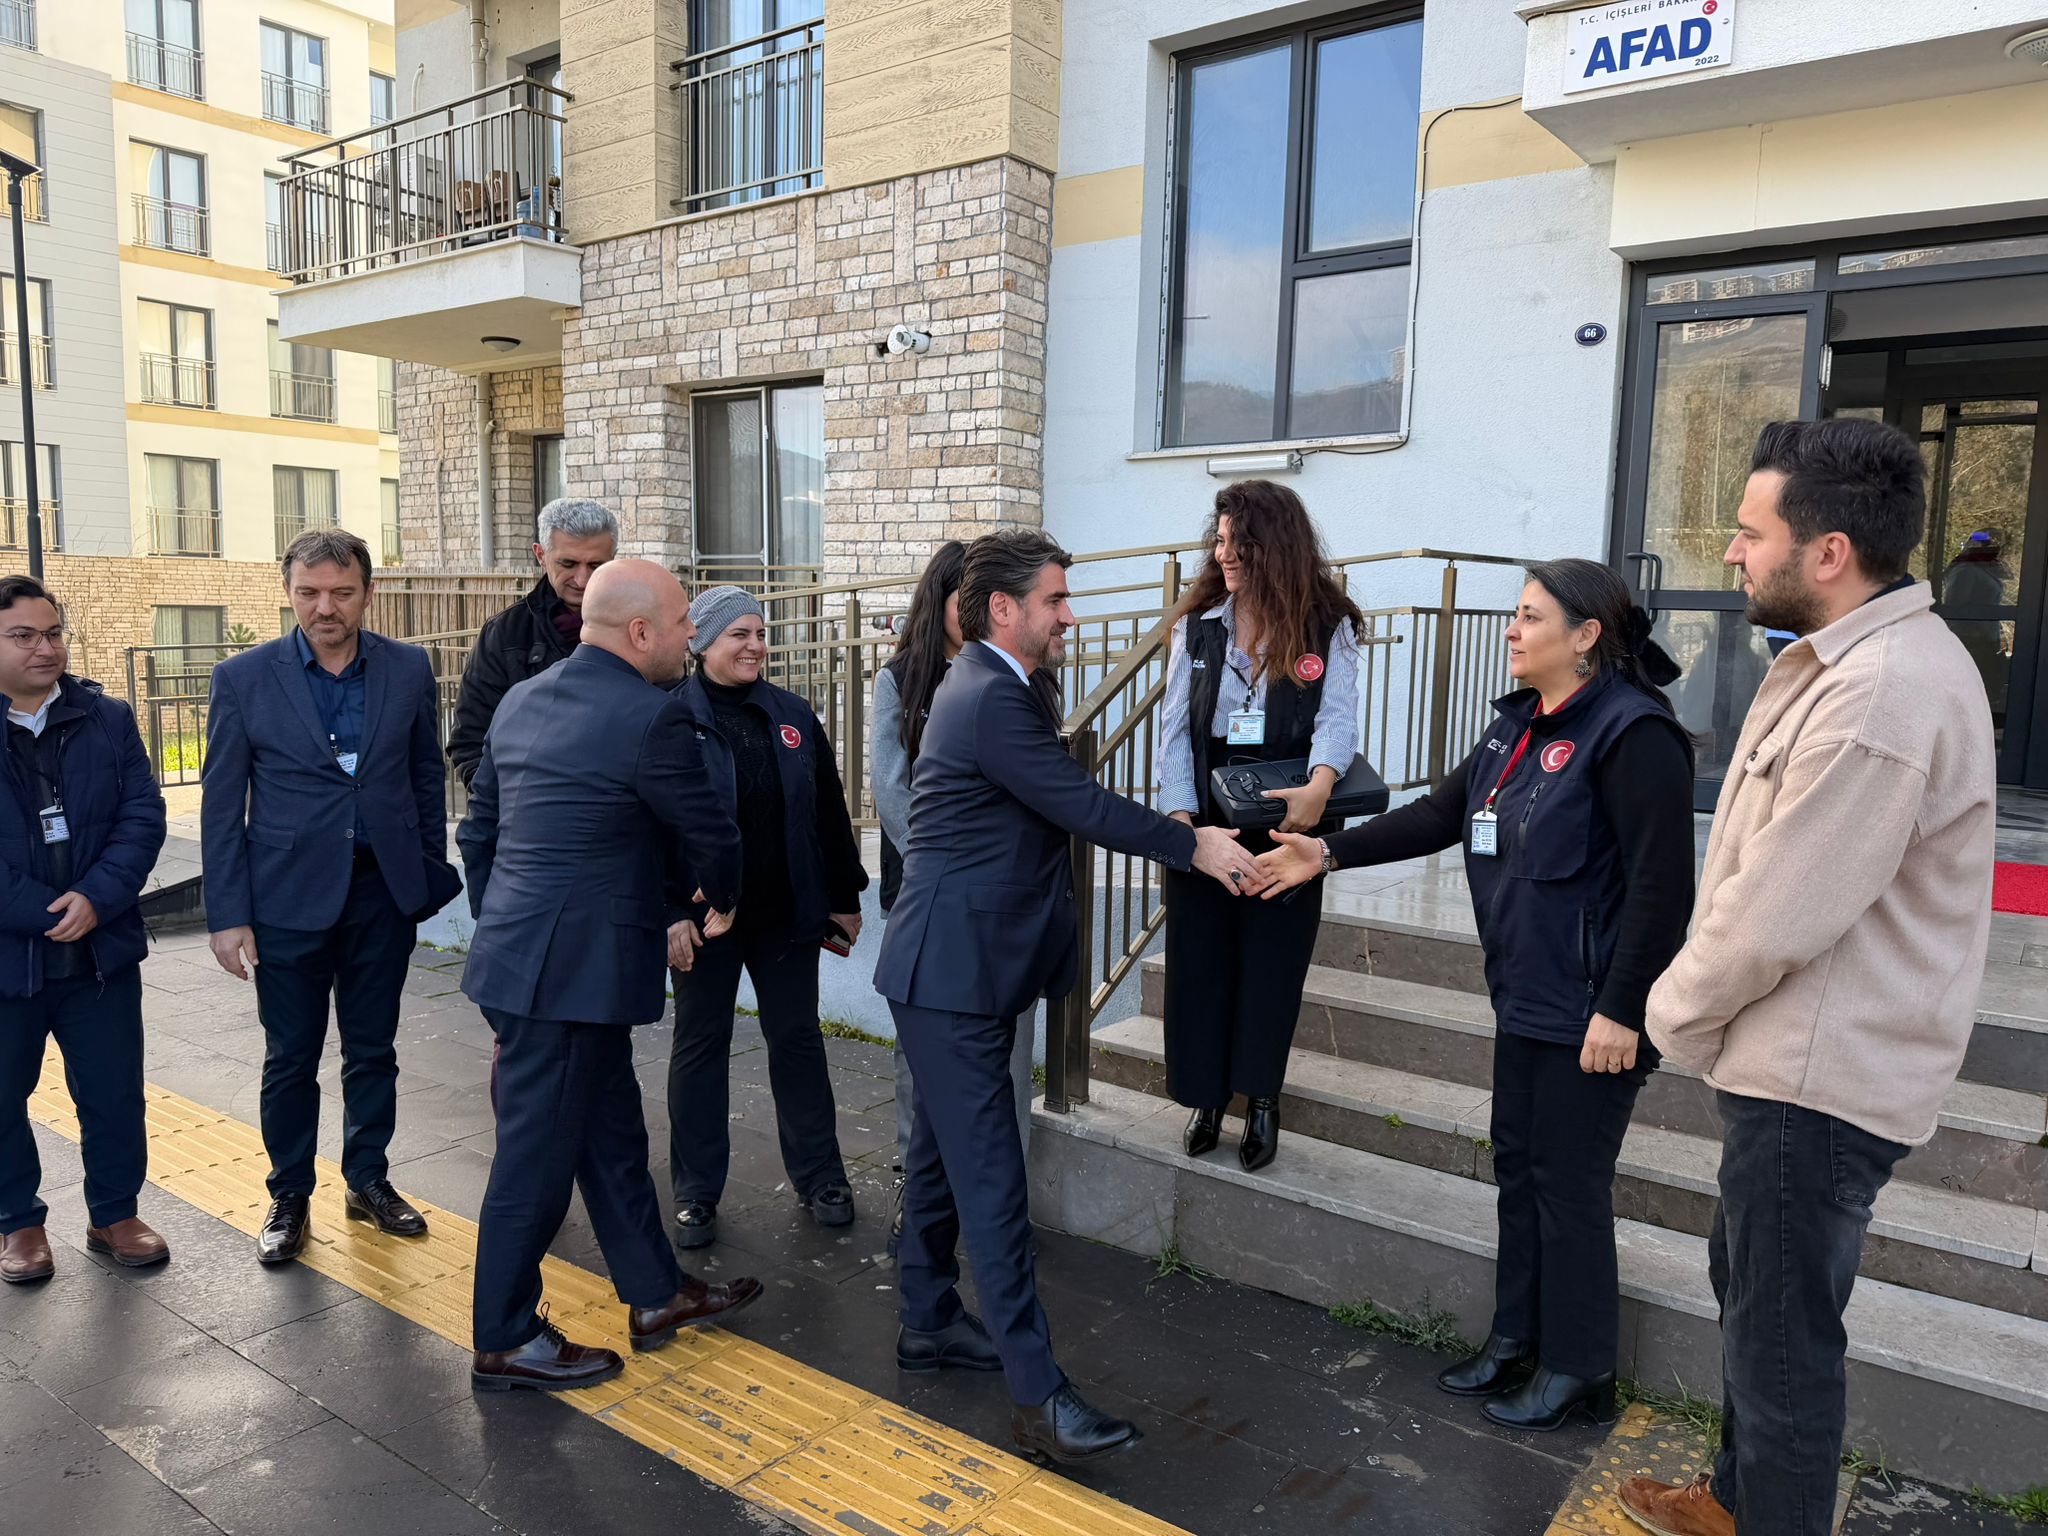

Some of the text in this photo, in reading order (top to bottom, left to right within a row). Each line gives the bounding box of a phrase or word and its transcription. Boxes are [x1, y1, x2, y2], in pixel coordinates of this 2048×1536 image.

[1579, 15, 1599, 26] T.C.
[1605, 2, 1652, 21] İÇİŞLERİ
[1583, 17, 1712, 79] AFAD
[1694, 54, 1720, 66] 2022
[1584, 327, 1597, 338] 66
